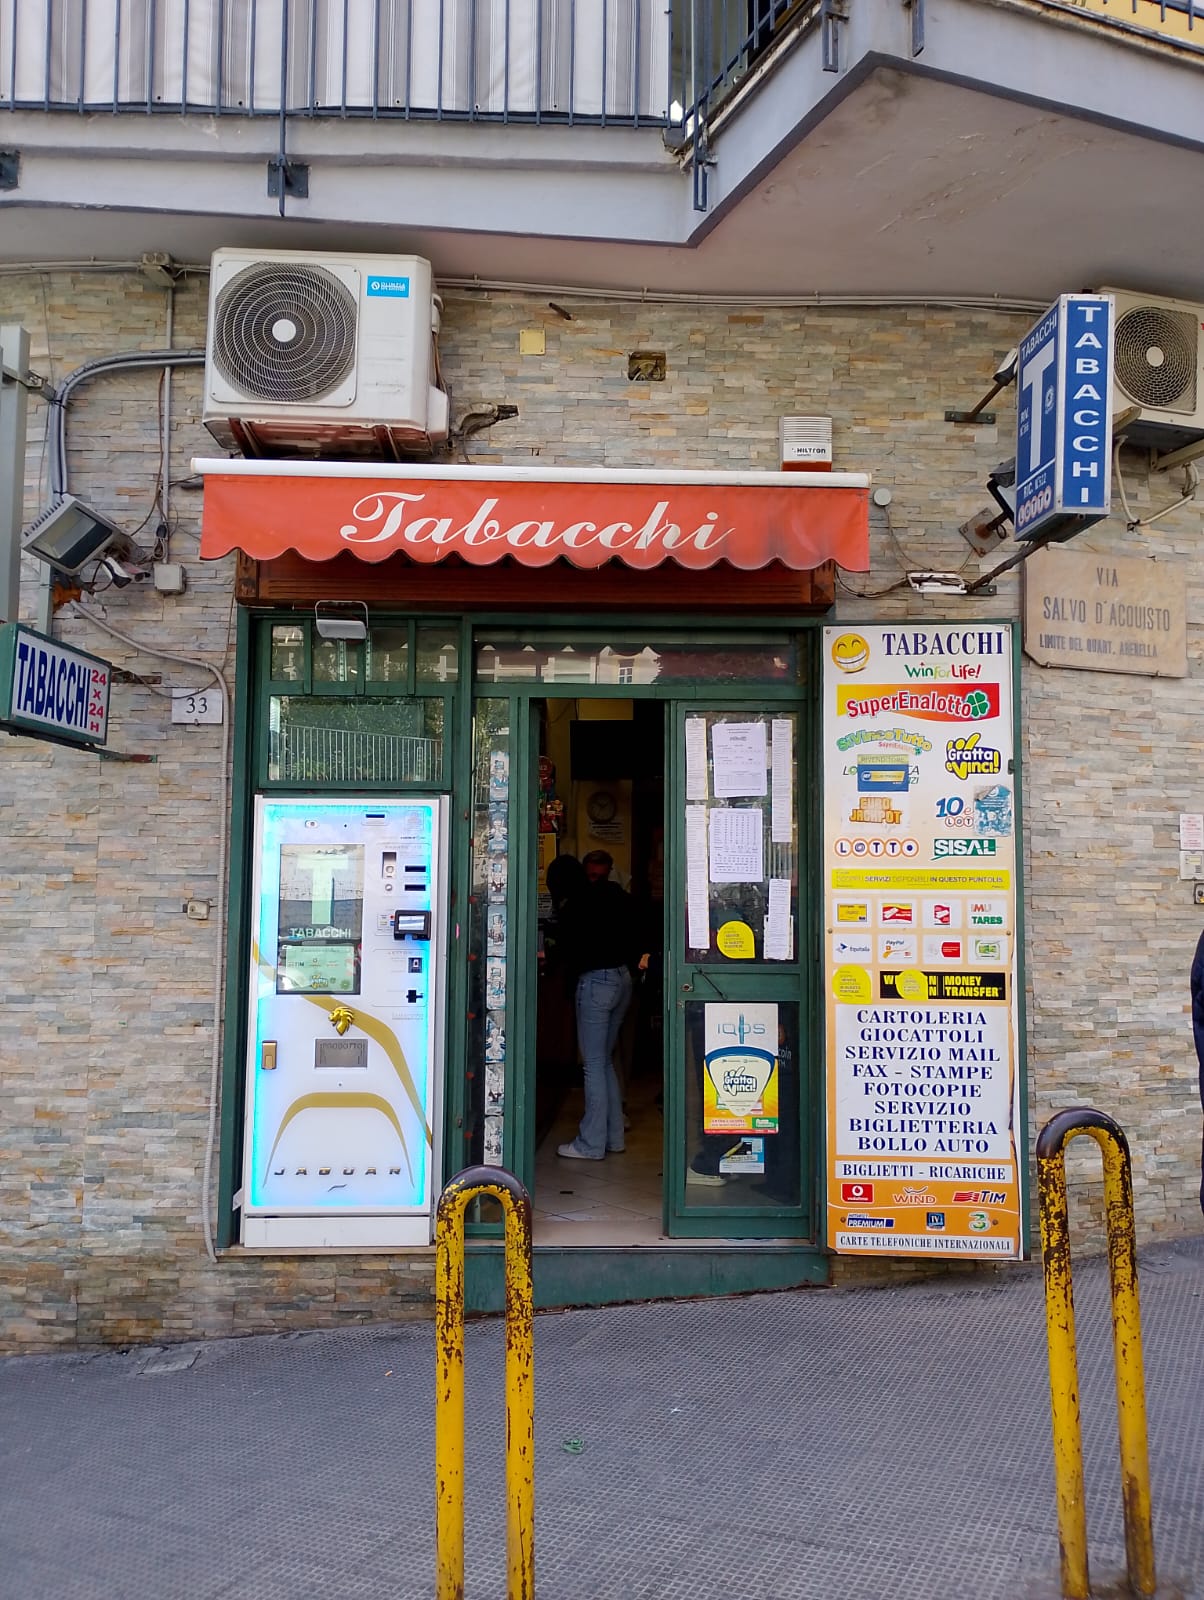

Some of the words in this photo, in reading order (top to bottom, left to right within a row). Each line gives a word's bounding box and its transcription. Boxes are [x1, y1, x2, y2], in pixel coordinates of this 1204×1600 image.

[1020, 312, 1058, 359] TABACCHI
[1022, 336, 1055, 473] T
[1073, 306, 1102, 503] TABACCHI
[340, 491, 736, 550] Tabacchi
[1097, 567, 1119, 587] VIA
[1043, 596, 1086, 623] SALVO
[882, 632, 1004, 657] TABACCHI
[1039, 633, 1066, 650] LIMITE
[17, 642, 91, 728] TABACCHI
[91, 669, 107, 686] 24
[89, 702, 104, 719] 24
[187, 696, 209, 715] 33
[846, 691, 972, 719] SuperEnalotto
[90, 721, 99, 733] H
[949, 748, 994, 761] Gratta
[951, 751, 1000, 779] Vinci!
[934, 838, 995, 856] SISAL
[971, 916, 1003, 925] TARES
[290, 927, 352, 938] TABACCHI
[945, 975, 982, 986] MONEY
[945, 986, 999, 998] TRANSFER
[857, 1010, 987, 1025] CARTOLERIA
[860, 1028, 984, 1044] GIOCATTOLI
[845, 1046, 941, 1061] SERVIZIO
[949, 1048, 1000, 1062] MAIL
[724, 1075, 755, 1085] Gratta
[853, 1064, 888, 1078] FAX
[911, 1065, 993, 1080] STAMPE
[864, 1082, 982, 1098] FOTOCOPIE
[875, 1101, 971, 1116] SERVIZIO
[849, 1118, 998, 1135] BIGLIETTERIA
[858, 1137, 927, 1151] BOLLO
[934, 1138, 989, 1153] AUTO
[273, 1167, 402, 1176] JAGUAR
[843, 1163, 914, 1178] BIGLIETTI
[930, 1165, 1006, 1180] RICARICHE
[893, 1194, 936, 1204] WIND
[981, 1190, 1006, 1203] TIM
[849, 1219, 884, 1227] PREMIUM
[969, 1213, 987, 1230] 3
[840, 1235, 868, 1247] CARTE
[871, 1236, 931, 1249] TELEFONICHE
[934, 1237, 1011, 1251] INTERNAZIONALI
